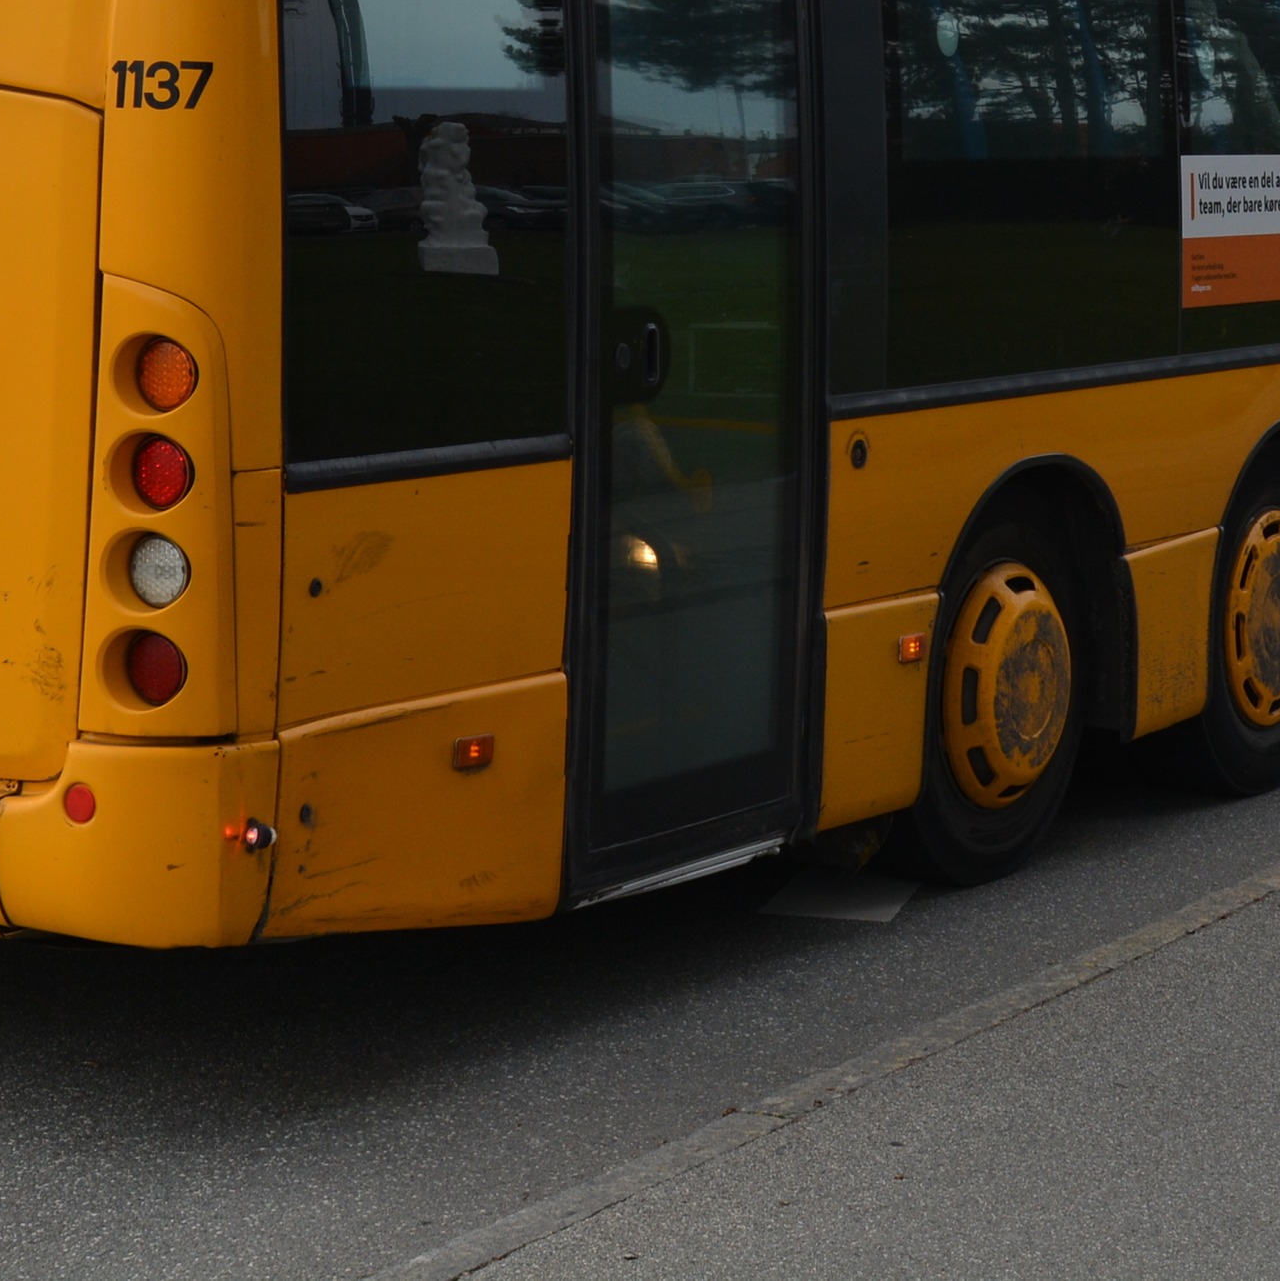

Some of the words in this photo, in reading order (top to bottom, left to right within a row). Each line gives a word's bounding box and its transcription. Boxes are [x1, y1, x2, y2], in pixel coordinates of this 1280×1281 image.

[111, 60, 213, 110] 1137
[1198, 172, 1210, 190] Vil
[1212, 172, 1223, 189] du
[1225, 176, 1247, 189] være
[1248, 176, 1259, 188] en
[1261, 171, 1274, 188] del
[1199, 198, 1225, 218] team,
[1226, 196, 1241, 213] der
[1243, 196, 1262, 213] bare
